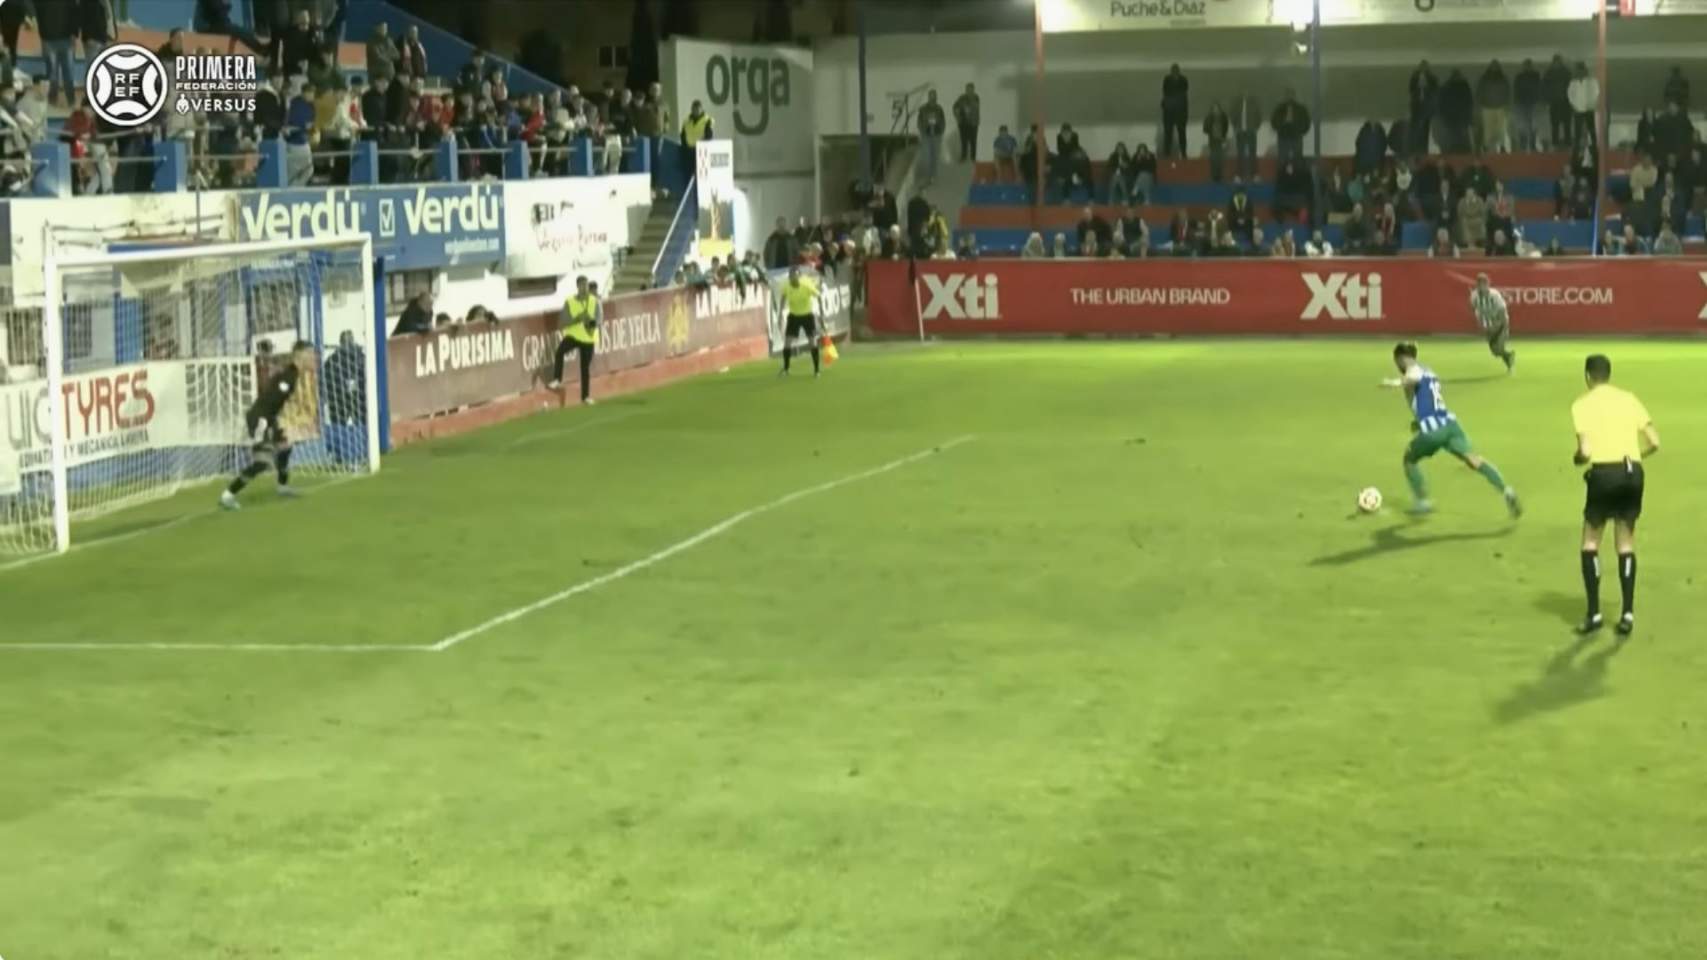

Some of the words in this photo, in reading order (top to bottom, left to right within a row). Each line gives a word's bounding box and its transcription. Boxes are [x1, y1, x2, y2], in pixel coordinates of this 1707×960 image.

[706, 54, 789, 135] orga
[242, 188, 361, 240] Verdú
[402, 184, 499, 235] Verdú
[921, 272, 1000, 320] Xti
[1070, 288, 1095, 305] THE
[1106, 288, 1168, 305] URBAN
[1169, 288, 1231, 305] BRAND
[1299, 272, 1383, 320] Xti
[1502, 287, 1613, 305] STORE.COM
[416, 342, 436, 377] LA
[438, 328, 514, 371] PURISIMA
[612, 317, 627, 350] DE
[628, 311, 661, 346] YECLA
[61, 369, 154, 440] TYRES
